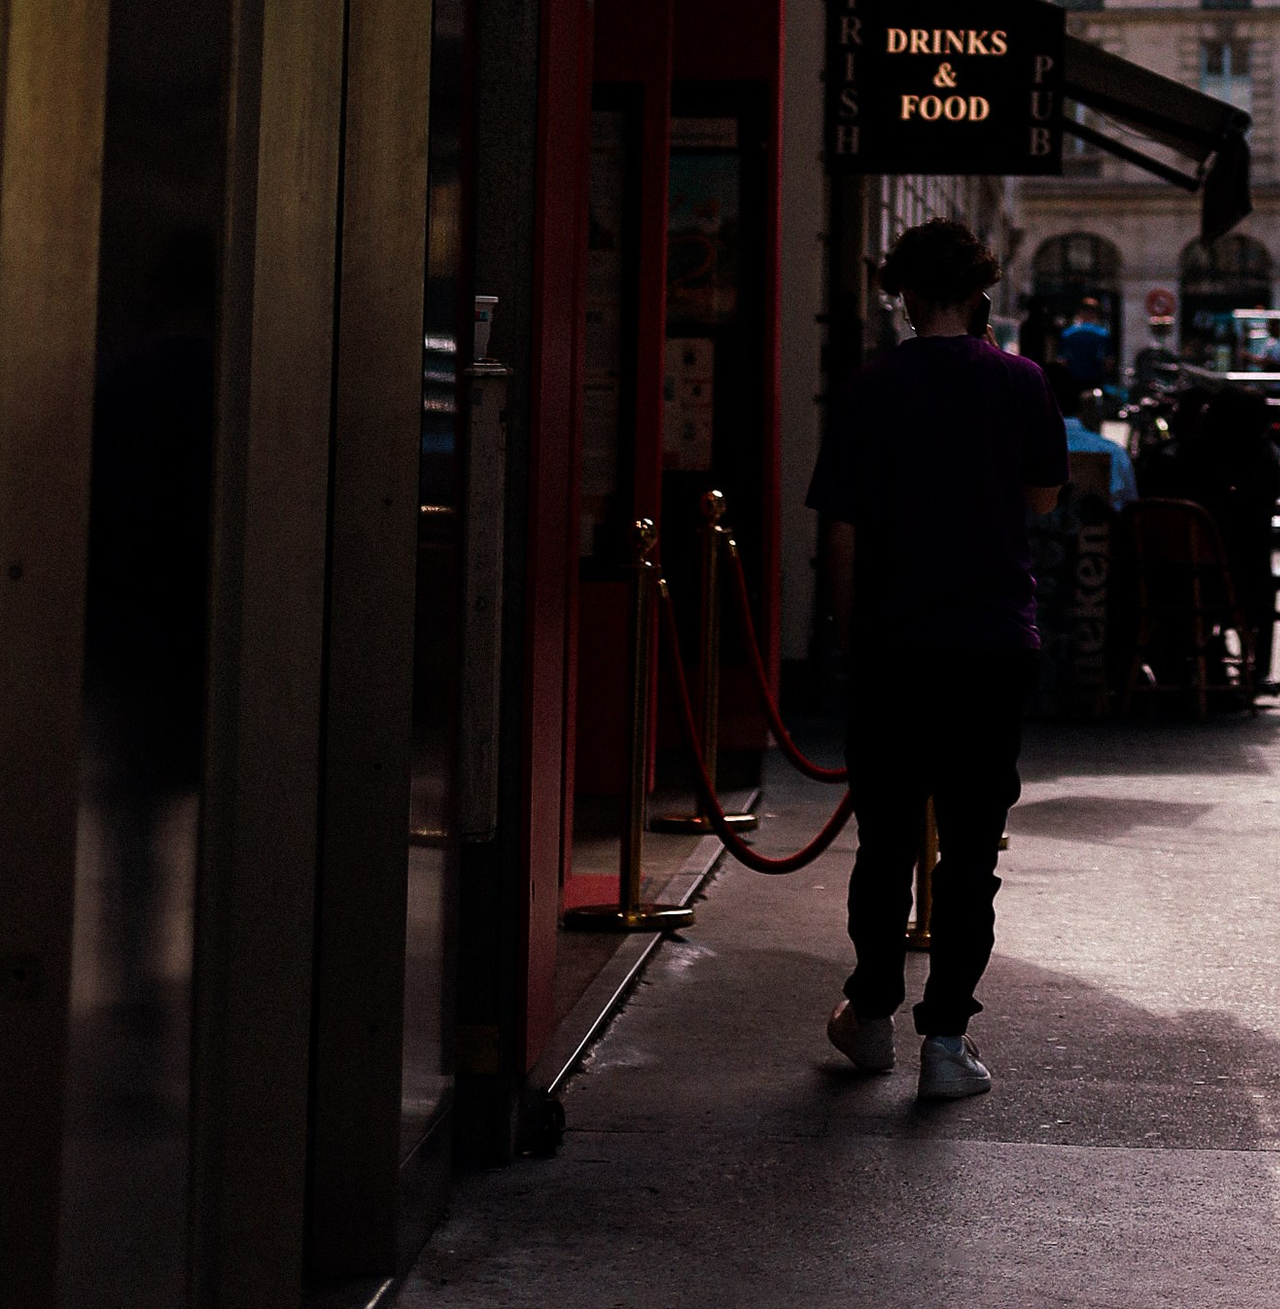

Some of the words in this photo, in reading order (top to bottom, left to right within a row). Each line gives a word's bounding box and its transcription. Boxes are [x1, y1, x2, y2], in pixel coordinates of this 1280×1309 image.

[886, 27, 1008, 56] DRINKS
[932, 61, 958, 88] &
[900, 94, 991, 122] FOOD
[1028, 54, 1055, 157] PUB
